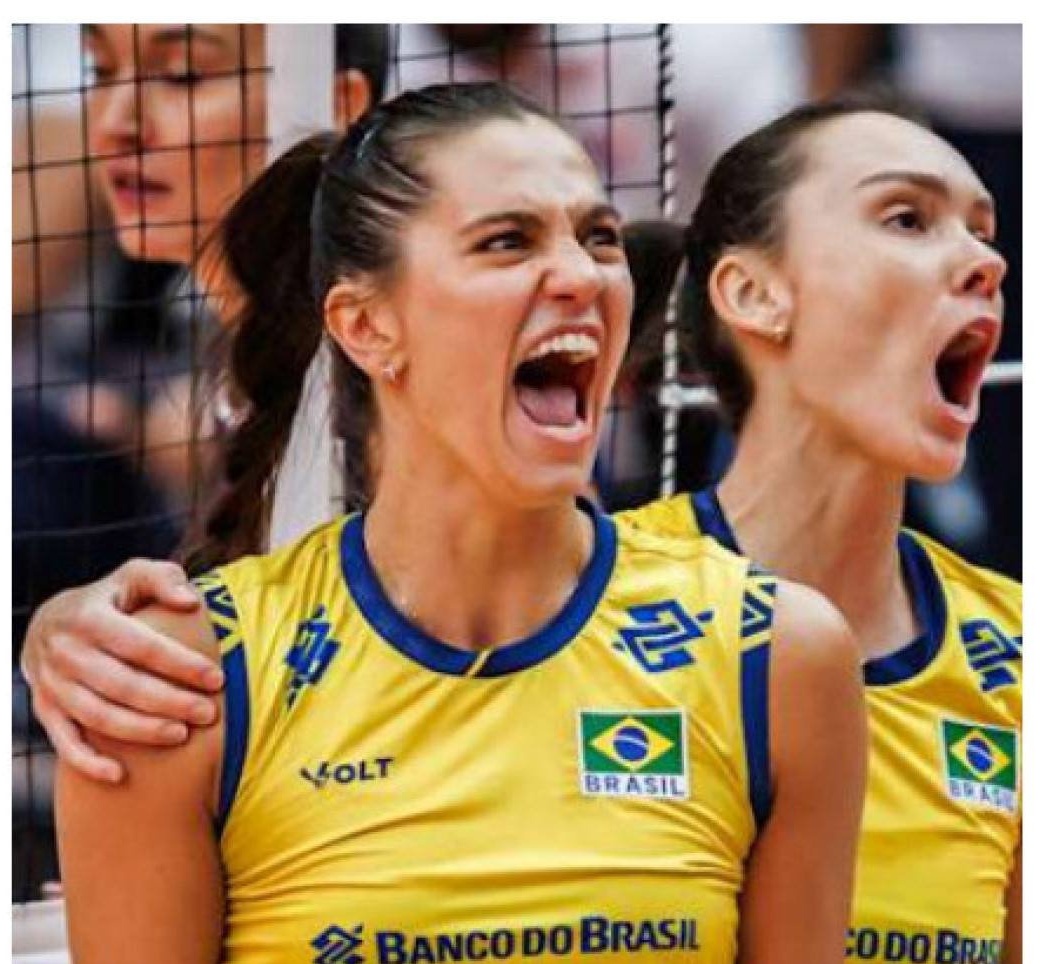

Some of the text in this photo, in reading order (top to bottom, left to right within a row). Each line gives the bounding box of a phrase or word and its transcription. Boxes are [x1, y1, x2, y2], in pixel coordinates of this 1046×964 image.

[298, 757, 394, 788] VOLT
[584, 775, 685, 796] BRASIL
[521, 924, 573, 958] DO
[579, 915, 701, 953] BRASIL
[885, 931, 931, 964] DO
